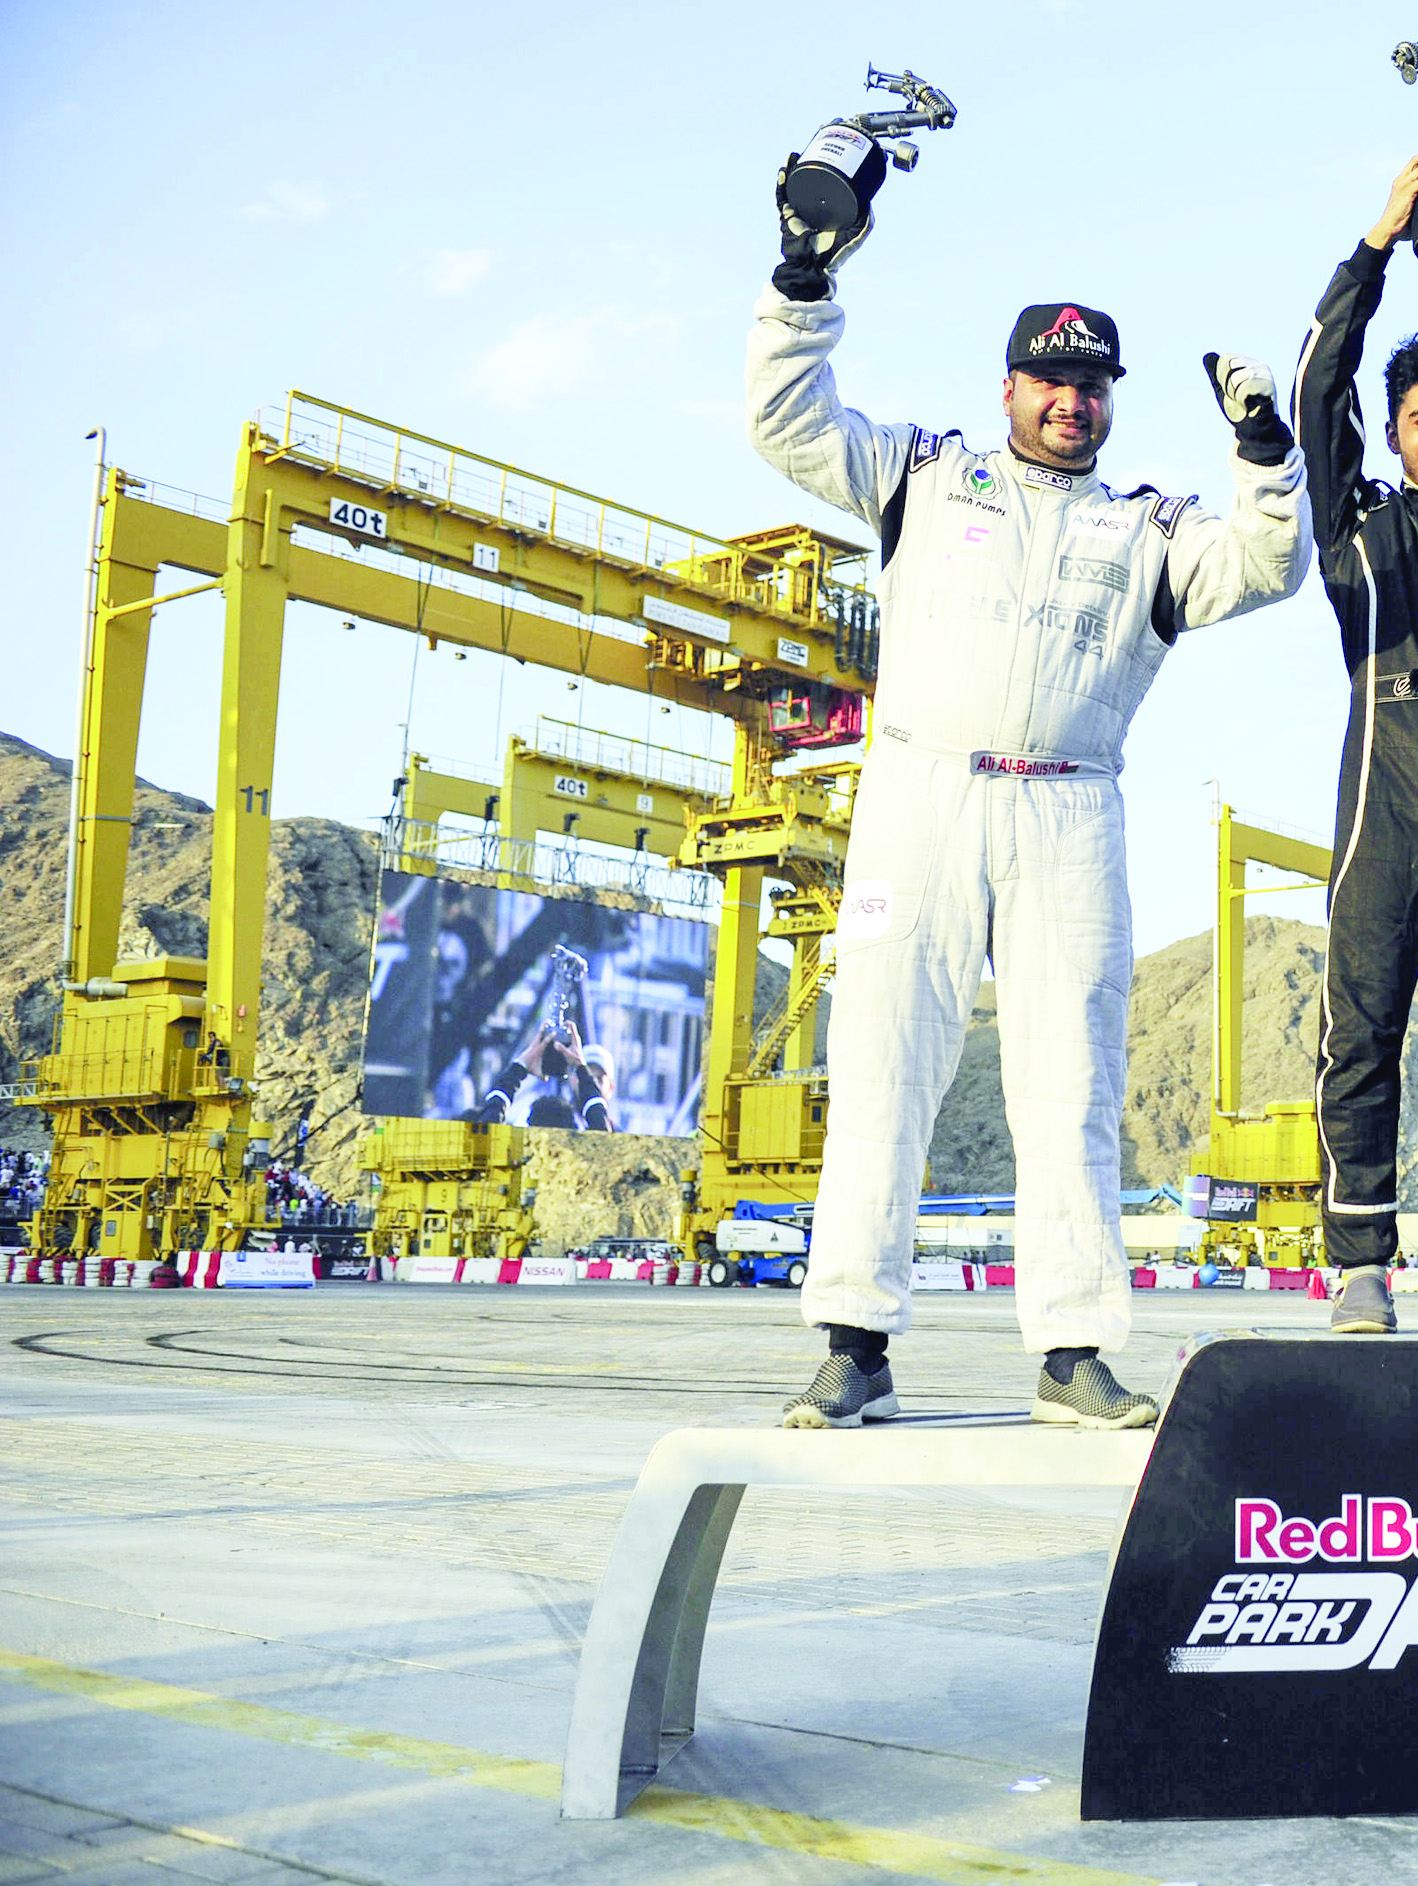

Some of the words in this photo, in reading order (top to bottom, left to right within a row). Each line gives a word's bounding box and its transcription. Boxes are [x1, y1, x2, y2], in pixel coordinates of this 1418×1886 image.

[1028, 334, 1046, 353] Ali
[1049, 332, 1065, 348] Al
[1069, 333, 1111, 356] Balushi
[1026, 466, 1073, 489] sparco
[947, 492, 973, 506] OMAN
[976, 500, 1007, 517] PUMPS
[334, 503, 382, 535] 40t
[478, 547, 497, 569] 11
[1074, 639, 1104, 660] 44
[976, 755, 995, 772] Ali
[998, 756, 1060, 776] Al-Balushi
[556, 778, 586, 796] 40t
[240, 785, 269, 816] 11
[640, 796, 650, 810] 9
[713, 839, 755, 855] ZPMC
[260, 1268, 279, 1276] while
[281, 1268, 306, 1278] driving
[522, 1266, 565, 1277] NISSAN
[1235, 1493, 1362, 1564] Red
[1211, 1573, 1295, 1602] CAR
[1186, 1601, 1357, 1645] PARK
